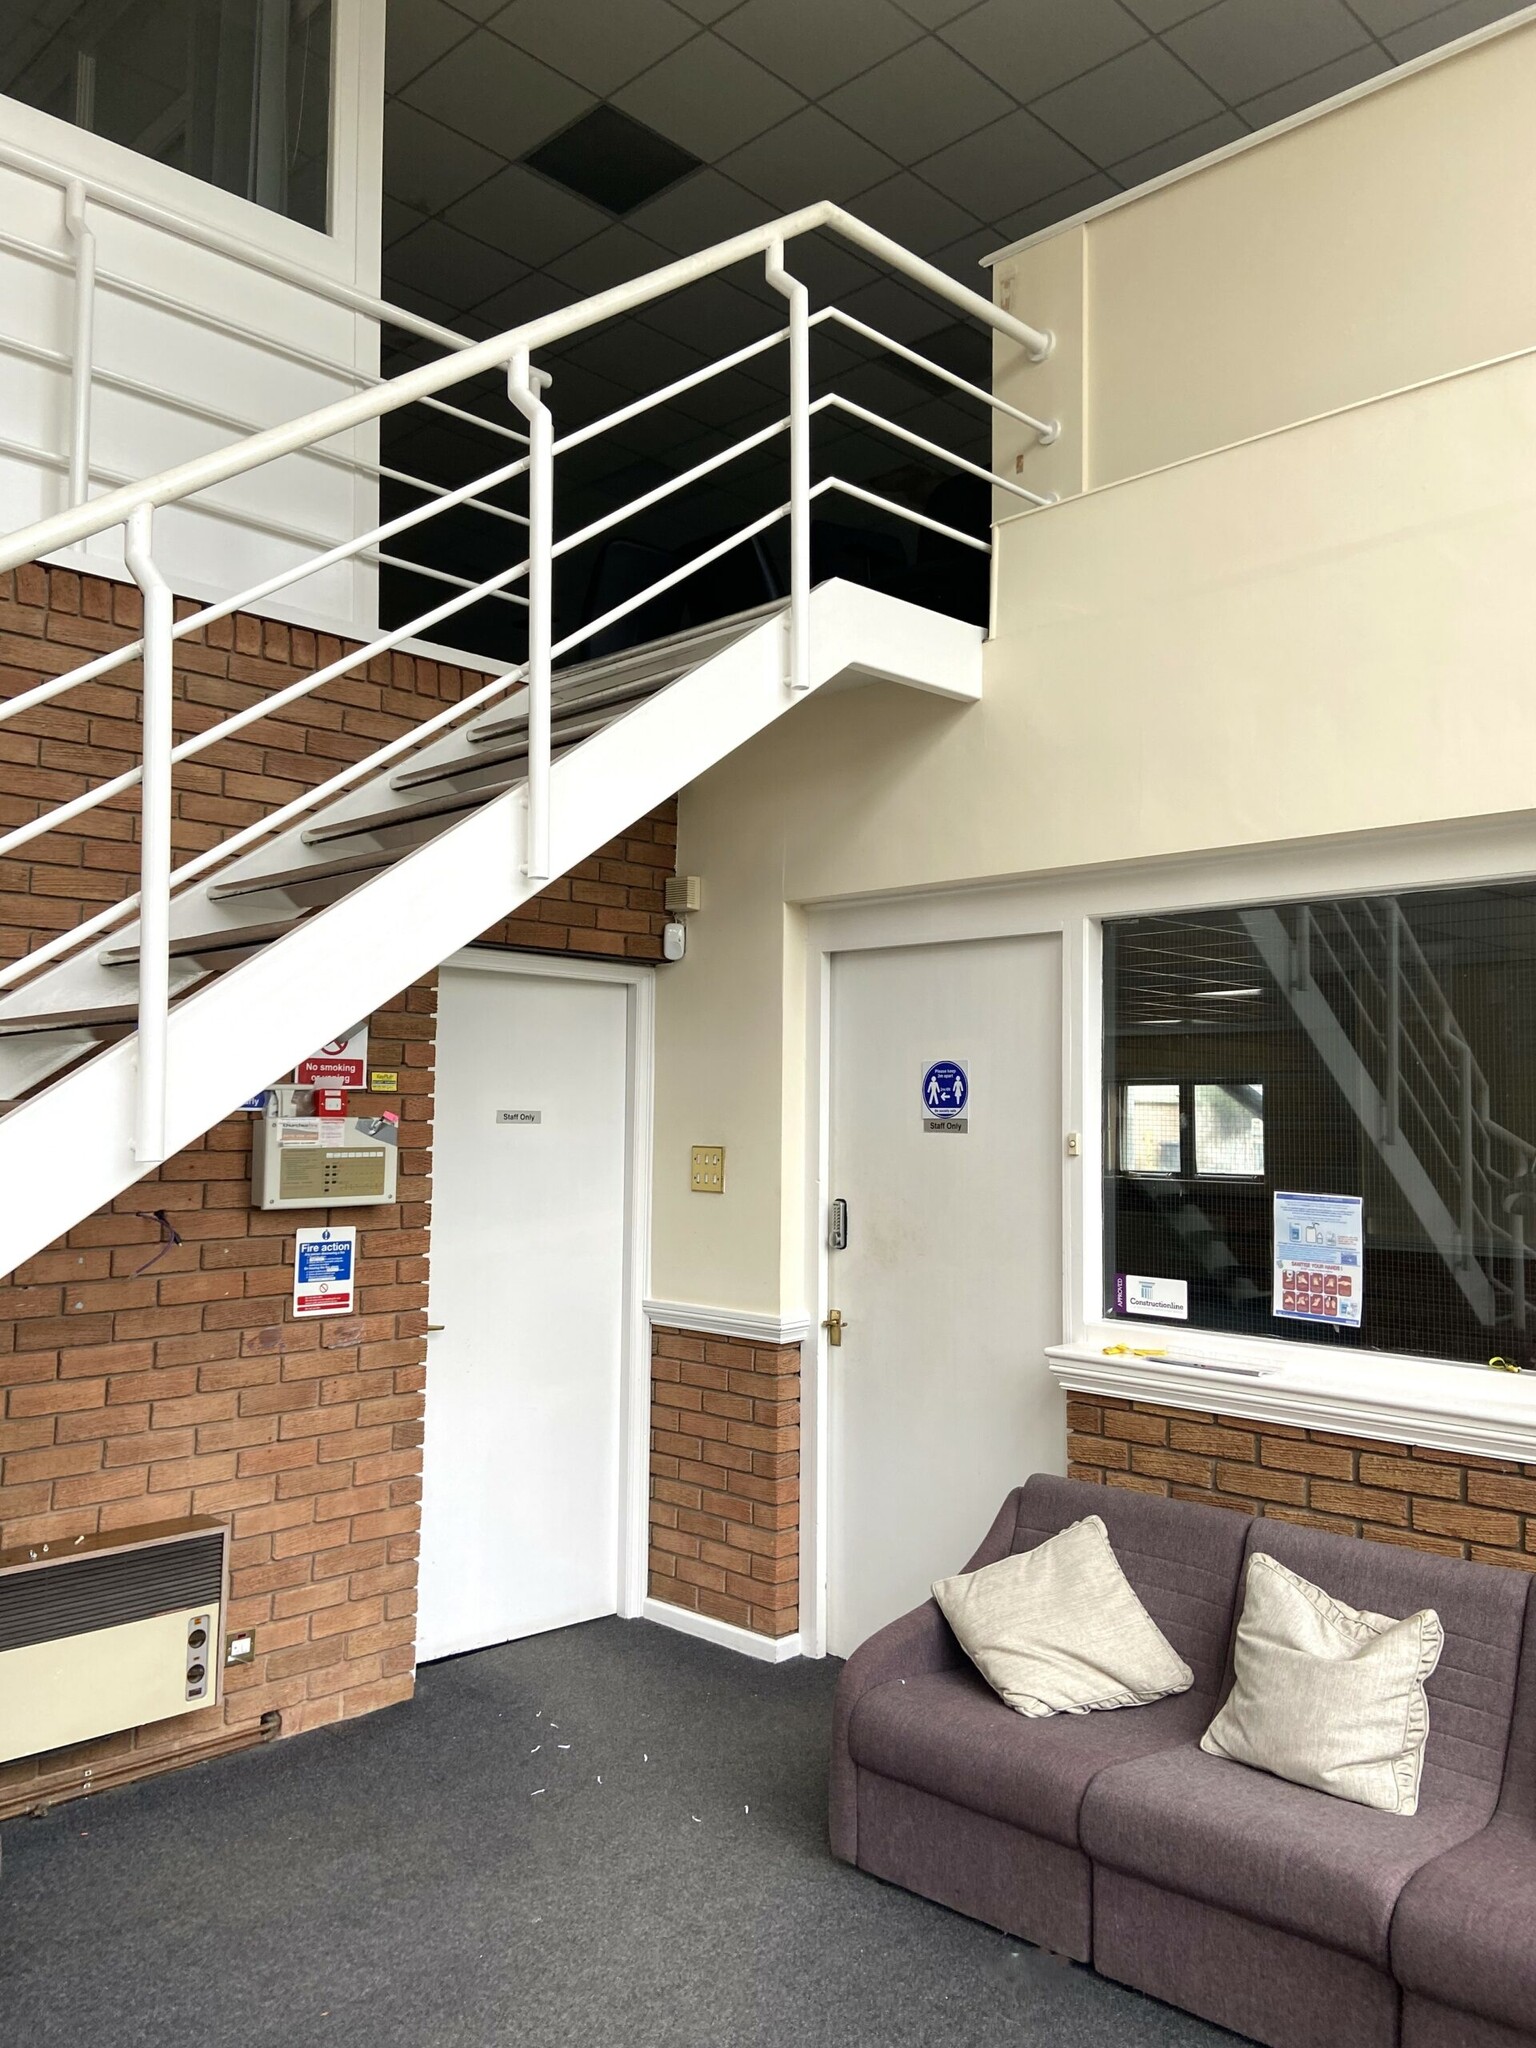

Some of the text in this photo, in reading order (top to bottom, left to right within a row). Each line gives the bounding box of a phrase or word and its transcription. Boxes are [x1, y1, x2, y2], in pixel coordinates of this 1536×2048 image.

[306, 1062, 356, 1074] No smoking
[520, 1113, 535, 1121] Only
[930, 1122, 962, 1131] Staff Only
[301, 1243, 350, 1253] Fire action
[1130, 1298, 1184, 1310] Constructionline
